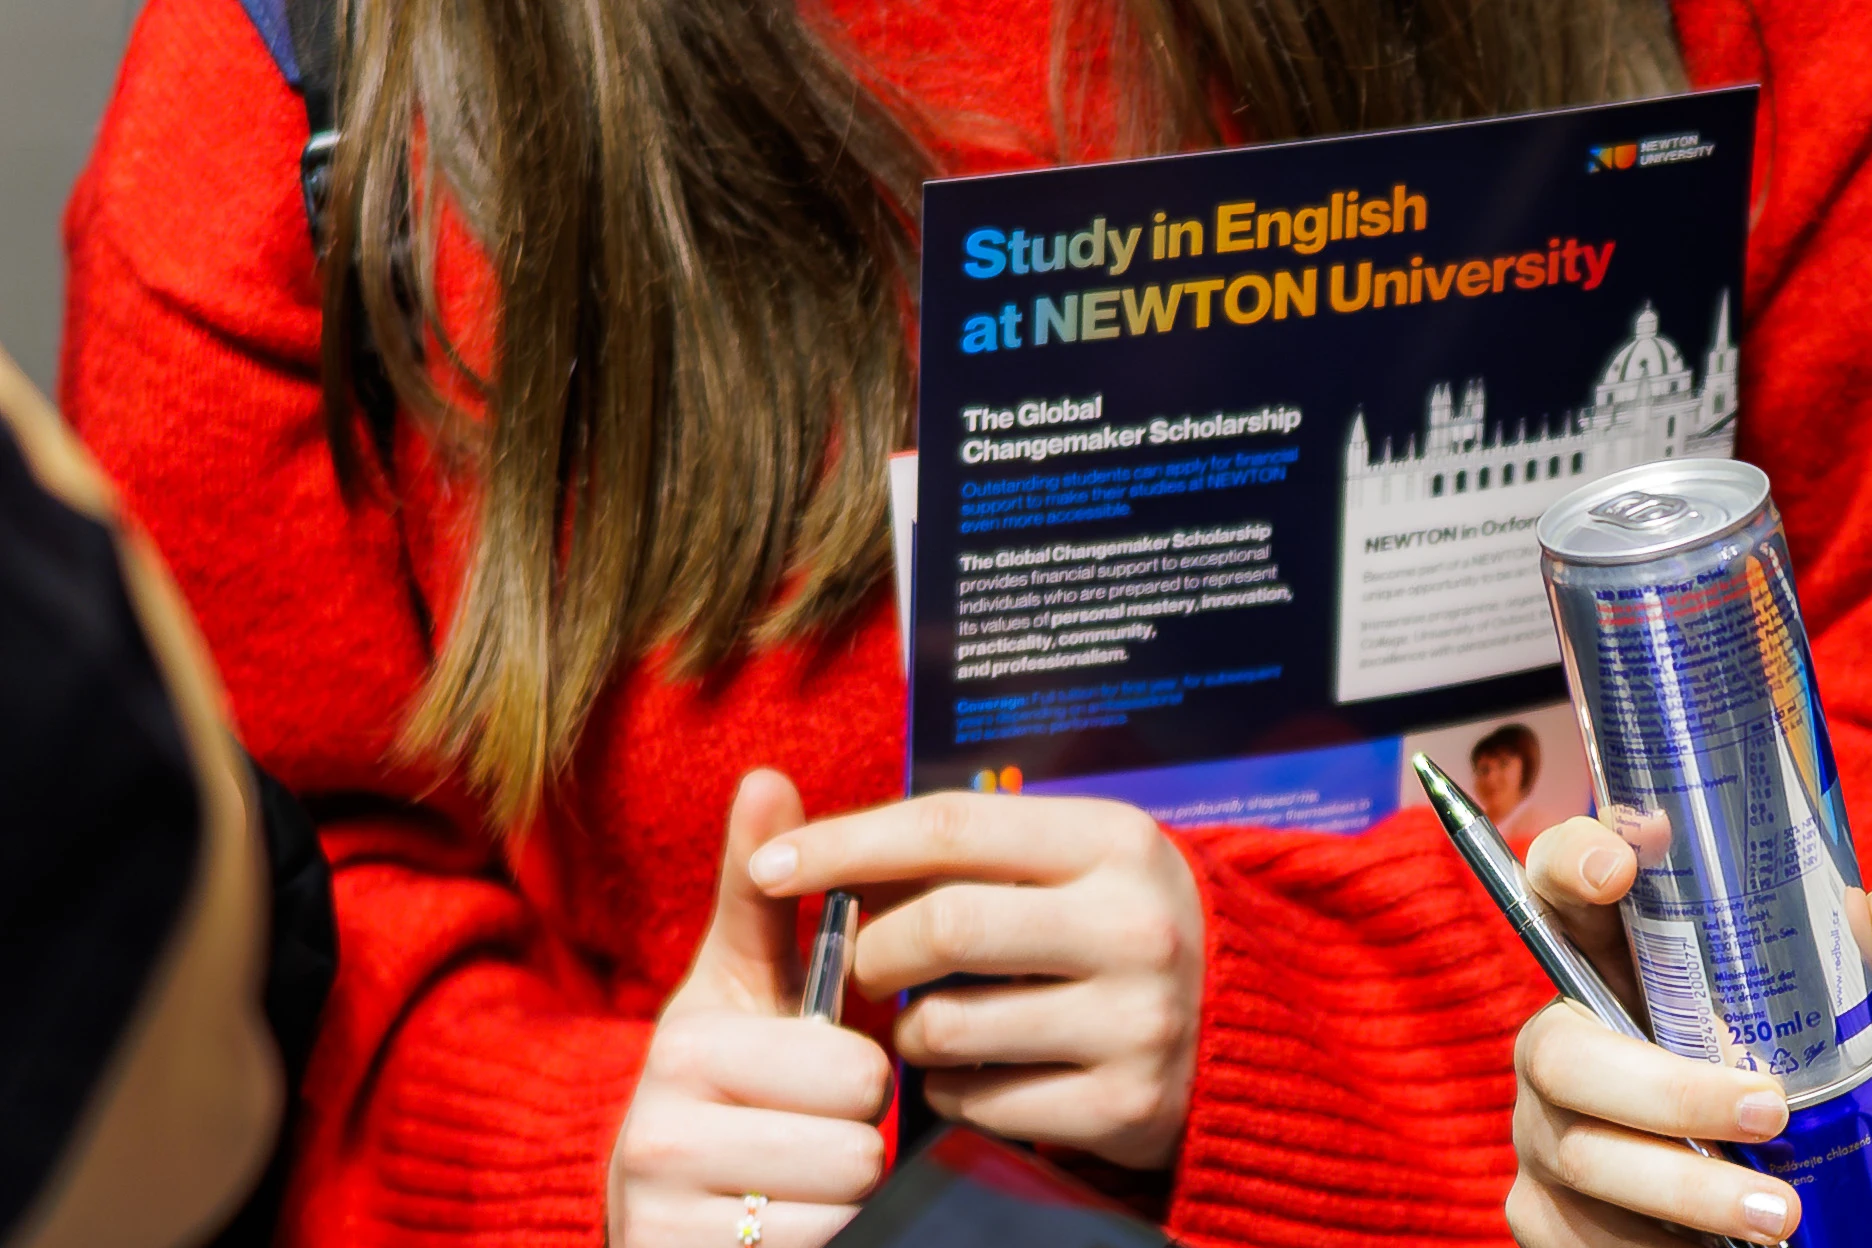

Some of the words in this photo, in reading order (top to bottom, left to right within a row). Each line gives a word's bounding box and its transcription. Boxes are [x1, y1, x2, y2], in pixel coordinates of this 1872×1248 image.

[1640, 132, 1698, 152] NEWTON
[1640, 145, 1714, 167] UNIVERSITY
[964, 218, 1141, 279] Study
[1152, 212, 1202, 259] in
[1216, 184, 1427, 255] English
[962, 305, 1022, 354] at
[1034, 268, 1317, 344] NEWTON
[1329, 238, 1616, 313] University
[962, 408, 1014, 431] The
[1018, 395, 1102, 427] Global
[961, 425, 1146, 463] Changemaker
[1149, 406, 1301, 444] Scholarship
[1062, 468, 1130, 487] students
[1133, 466, 1158, 480] can
[1164, 456, 1206, 481] apply
[960, 554, 994, 571] The
[995, 547, 1050, 567] Global
[1052, 536, 1171, 562] Changemaker
[1172, 524, 1272, 548] Scholarship
[1364, 527, 1458, 552] NEWTON
[1460, 526, 1477, 539] in
[1480, 516, 1538, 536] Oxfor
[959, 574, 1028, 596] provides
[1030, 565, 1095, 584] financial
[1097, 558, 1159, 578] support
[1160, 557, 1177, 571] to
[1179, 545, 1271, 568] exceptional
[959, 592, 1042, 615] individuals
[1043, 589, 1077, 605] who
[1079, 588, 1106, 601] are
[1108, 577, 1182, 600] prepared
[1184, 576, 1200, 589] to
[1202, 566, 1278, 588] represent
[959, 621, 976, 636] its
[979, 617, 1030, 633] values
[1031, 612, 1050, 627] of
[1051, 603, 1125, 629] personal
[1127, 599, 1199, 616] mastery,
[1200, 586, 1292, 609] innovation,
[957, 635, 1057, 660] practicality,
[1058, 623, 1157, 650] community,
[956, 660, 990, 679] and
[990, 648, 1128, 678] professionalism.
